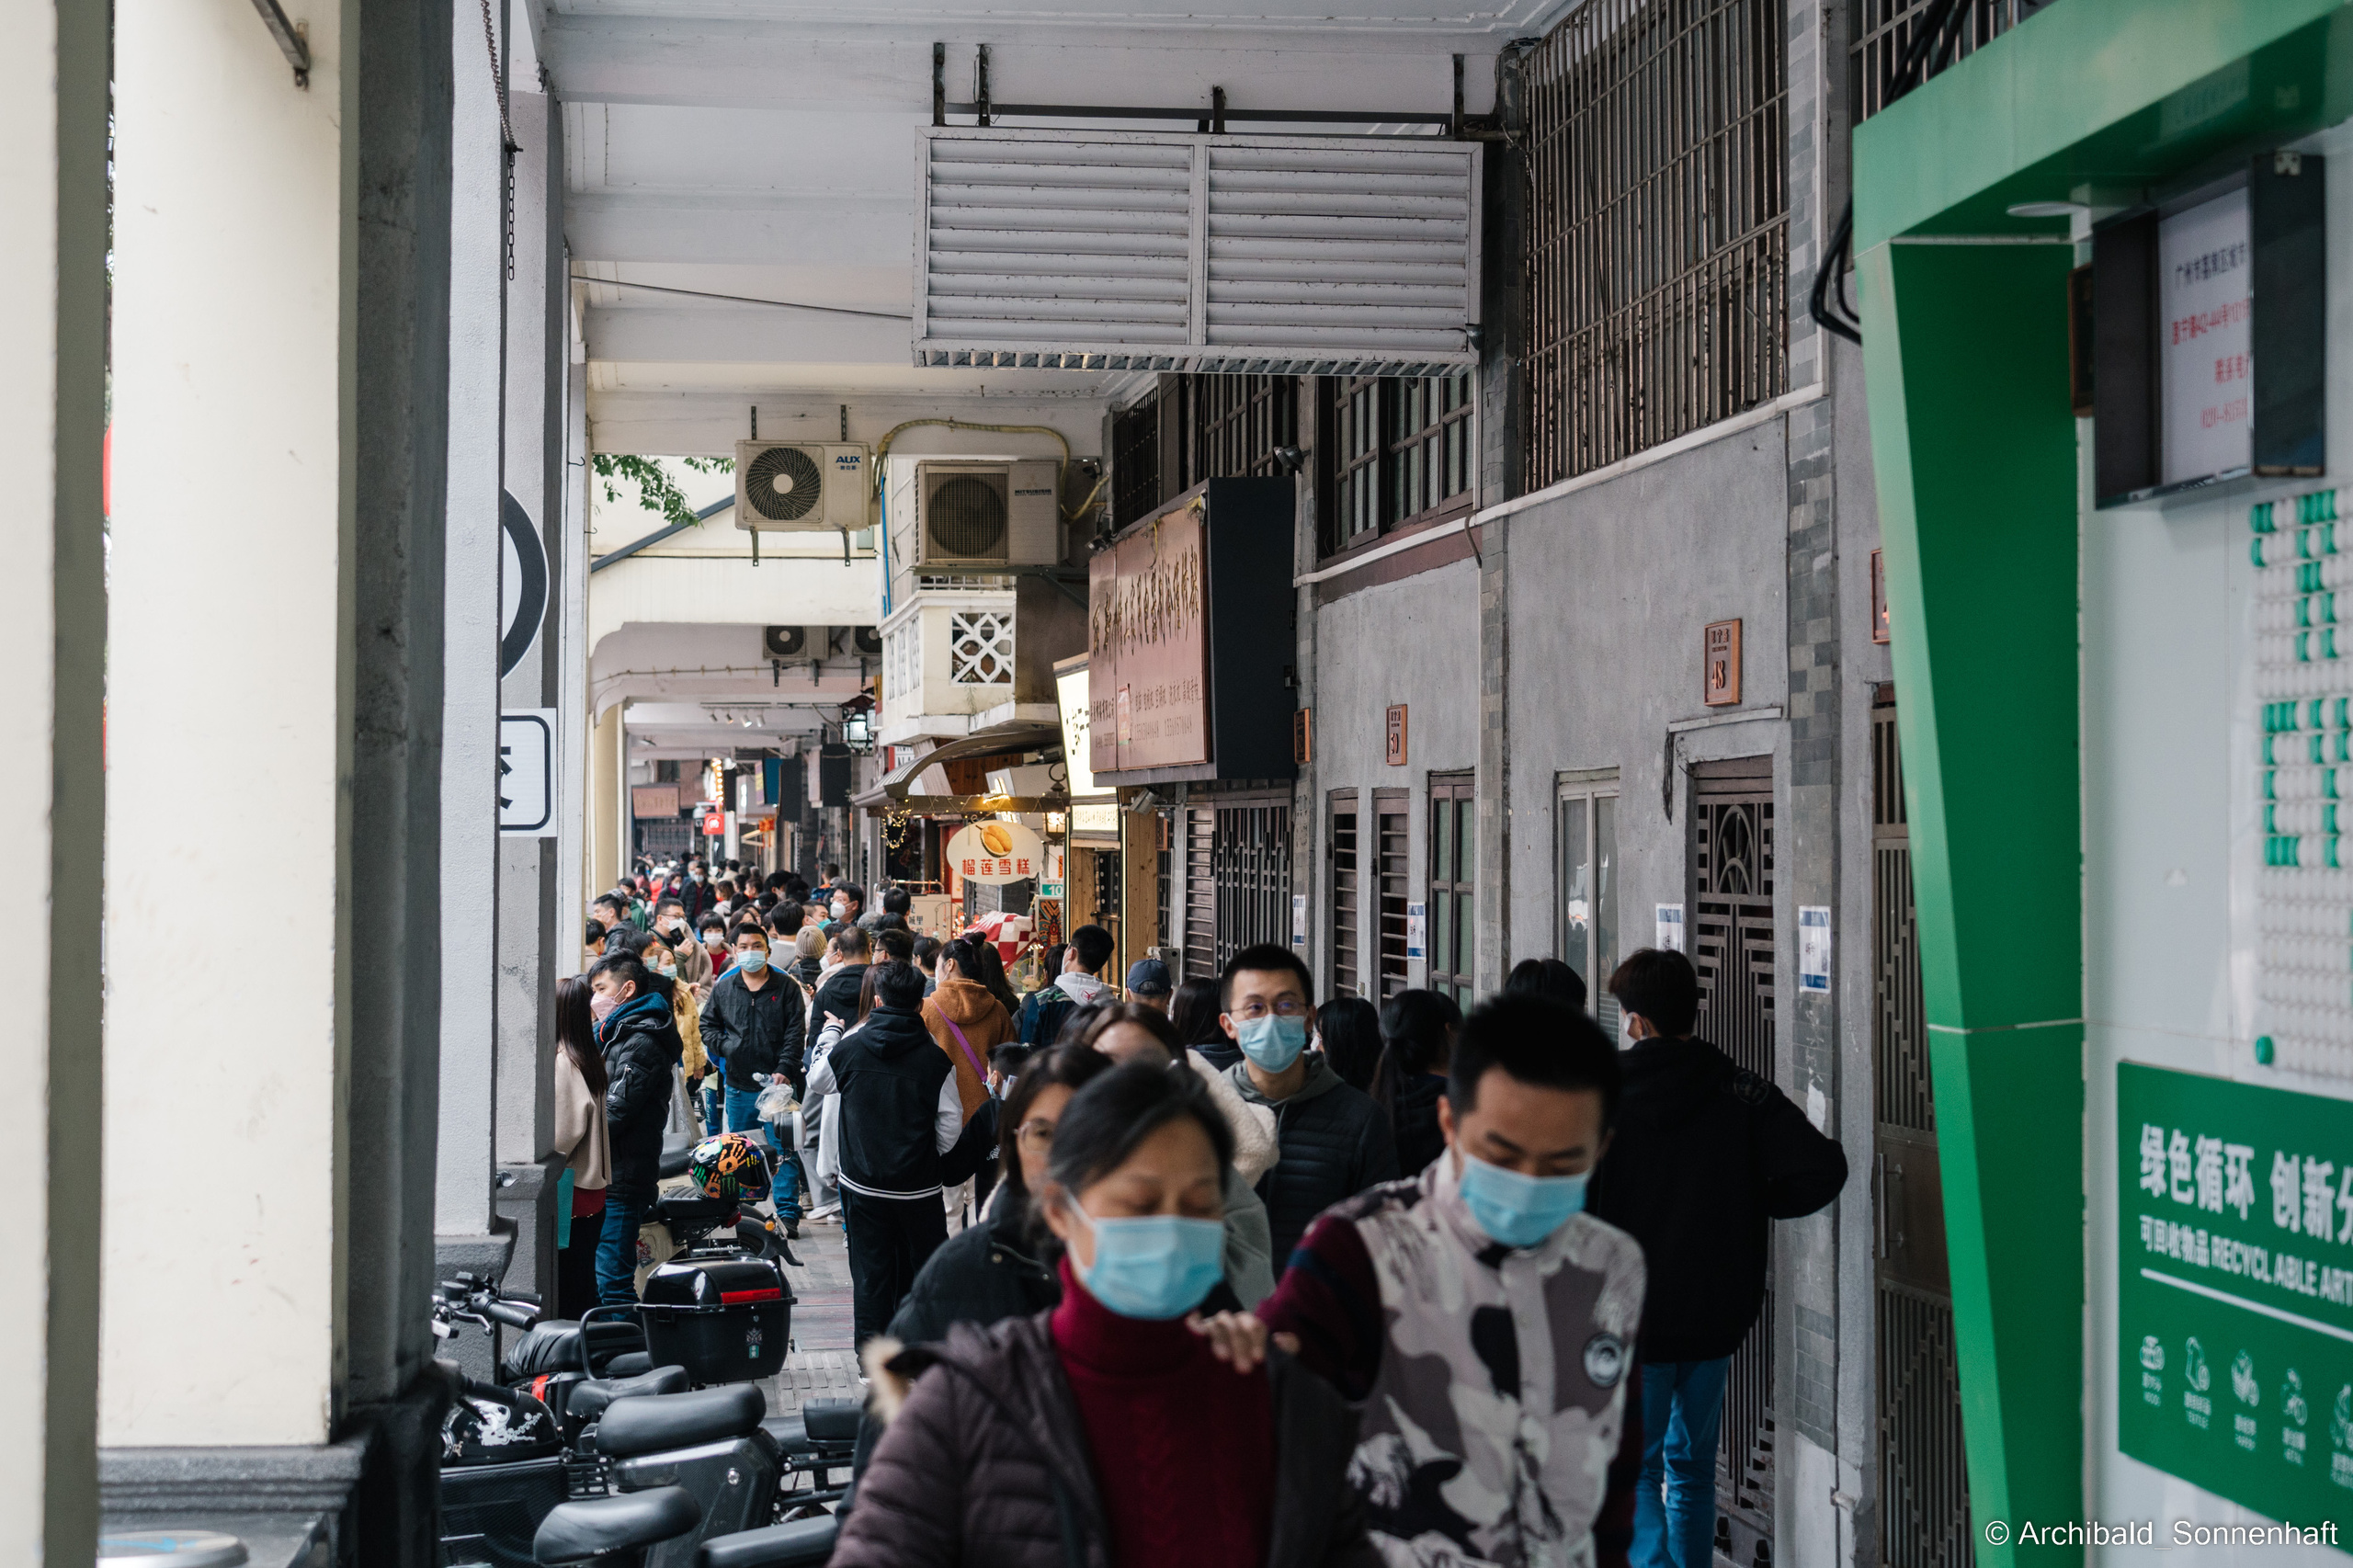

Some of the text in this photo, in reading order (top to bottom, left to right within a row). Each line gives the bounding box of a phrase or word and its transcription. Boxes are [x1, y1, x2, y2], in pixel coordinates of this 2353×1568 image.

[1711, 660, 1726, 689] 48
[961, 858, 1030, 876] 榴莲雪糕
[2139, 1122, 2256, 1221] 绿色循环
[2139, 1214, 2211, 1268] 可回收物品
